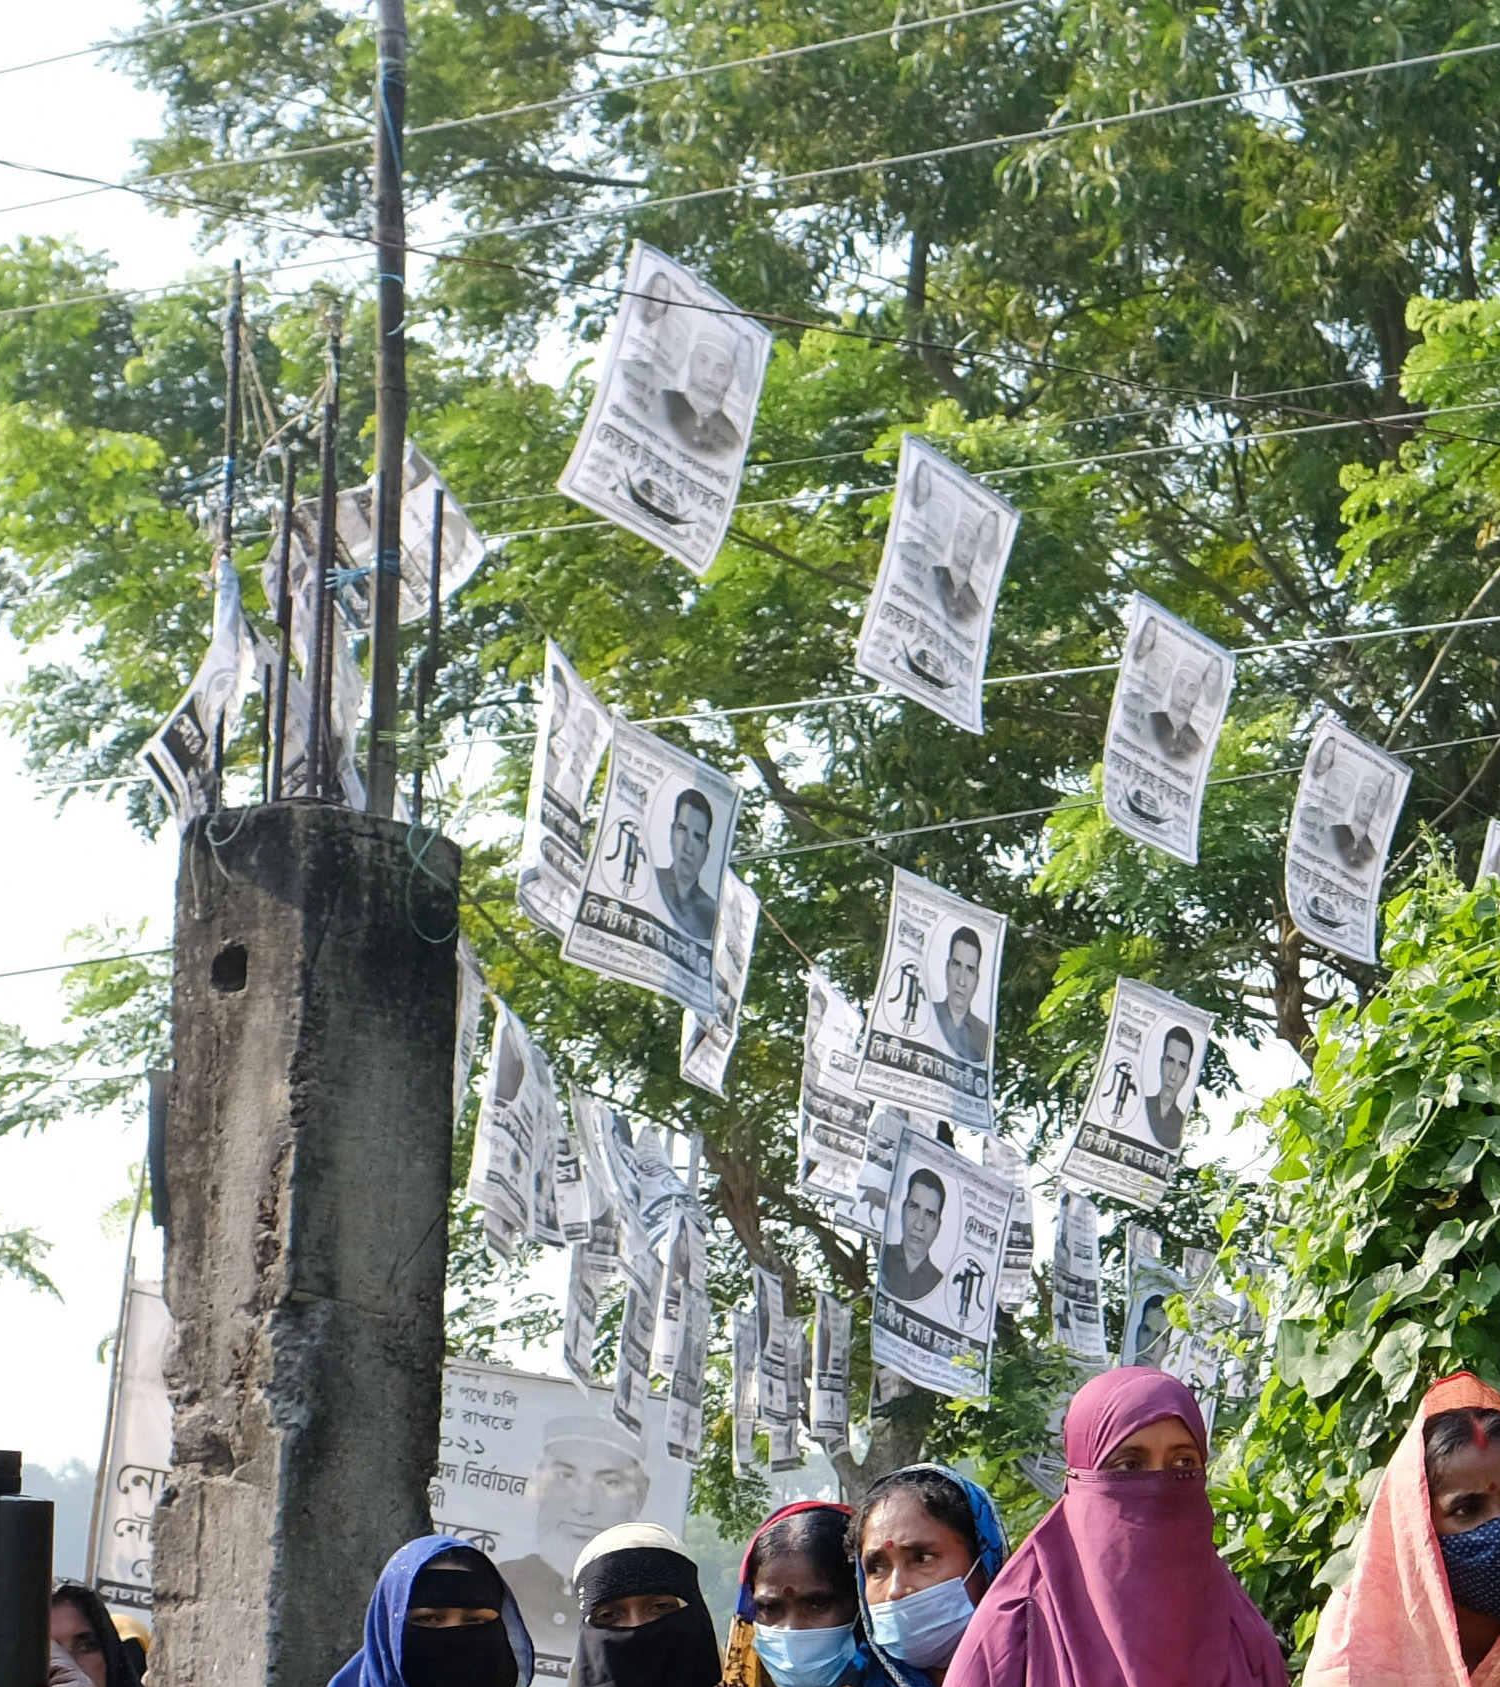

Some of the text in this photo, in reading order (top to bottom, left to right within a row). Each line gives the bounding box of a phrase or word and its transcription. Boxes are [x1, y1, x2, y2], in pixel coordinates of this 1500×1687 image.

[458, 1386, 488, 1403] পথে
[493, 1389, 519, 1410] চলি
[461, 1409, 515, 1431] রাখতে
[461, 1460, 529, 1496] নির্বাচনে
